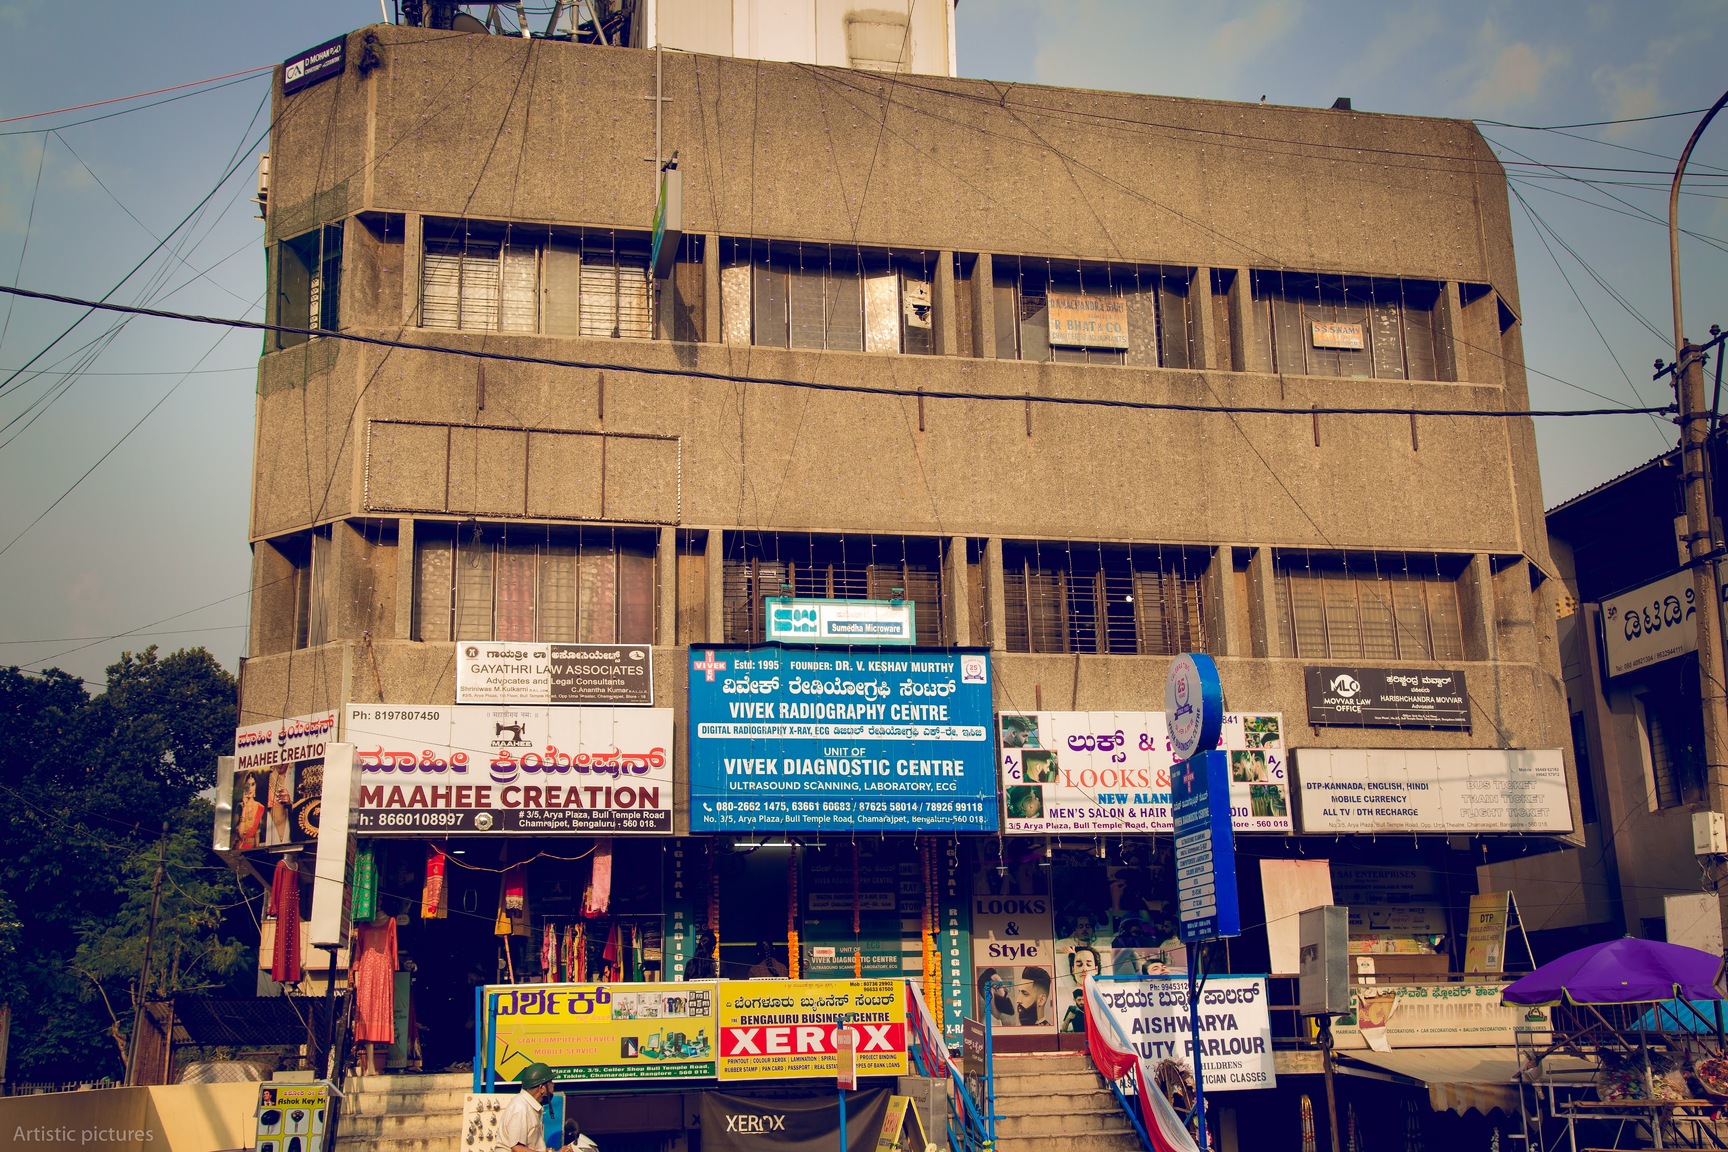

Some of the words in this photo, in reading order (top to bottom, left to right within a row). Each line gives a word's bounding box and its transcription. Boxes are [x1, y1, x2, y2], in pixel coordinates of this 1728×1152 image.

[832, 623, 864, 632] Sumedha
[865, 623, 901, 634] Microware
[533, 651, 546, 659] ಲಾ
[471, 664, 532, 674] GAYATHRI
[536, 665, 563, 675] LAW
[566, 665, 644, 676] ASSOCIATES
[734, 660, 755, 670] Estd:
[758, 660, 779, 670] 1995
[790, 661, 832, 671] FOUNDER:
[835, 661, 853, 671] DR.
[856, 661, 865, 671] V.
[868, 661, 908, 672] KESHAV
[911, 662, 954, 673] MURTHY
[486, 677, 531, 686] Advocates
[532, 677, 548, 685] and
[551, 678, 574, 687] Legal
[576, 678, 625, 686] Consultants
[722, 676, 780, 694] ವಿವೇಕ್
[899, 678, 957, 697] ಸೆಂಟರ್
[1177, 679, 1186, 693] 25
[1330, 679, 1361, 692] MLO
[1324, 698, 1355, 706] MOVVAR
[1356, 698, 1372, 706] LAW
[1380, 695, 1435, 703] HARISHCHANDRA
[1436, 696, 1463, 704] MOVVAR
[729, 702, 775, 719] VIVEK
[779, 702, 886, 720] RADIOGRAPHY
[891, 704, 949, 721] CENTRE
[1336, 705, 1361, 713] OFFICE
[353, 711, 371, 720] Ph:
[374, 711, 440, 721] 8197807450
[702, 725, 731, 735] DIGITAL
[733, 726, 786, 735] RADIOGRAPHY
[789, 726, 813, 736] X-RAY,
[815, 726, 830, 735] ECG
[824, 747, 849, 756] UNIT
[851, 747, 866, 756] OF
[1067, 730, 1127, 763] ಲುಕ್ಸ್
[1138, 733, 1156, 751] &
[238, 750, 279, 770] MAAHEE
[358, 744, 468, 773] ಮಾಹೀ
[724, 758, 778, 775] VIVEK
[784, 759, 890, 776] DIAGNOSTIC
[896, 759, 965, 776] CENTRE
[1065, 768, 1150, 788] LOOKS
[1155, 768, 1171, 788] &
[729, 781, 801, 790] ULTRASOUND
[803, 781, 861, 791] SCANNING,
[864, 782, 934, 792] LABORATORY,
[936, 782, 957, 791] ECG
[1306, 782, 1366, 791] DTP-KANNADA,
[1368, 783, 1405, 791] ENGLISH,
[1466, 780, 1491, 790] BUS
[1493, 780, 1537, 790] TICKET
[360, 786, 492, 808] MAAHEE
[501, 786, 659, 808] CREATION
[1098, 793, 1129, 804] NEW
[1331, 795, 1362, 803] MOBILE
[1364, 795, 1407, 803] CURRENCY
[1461, 794, 1498, 804] TRAIN
[1500, 794, 1545, 804] TICKET
[716, 801, 761, 811] 080-2662
[763, 801, 789, 812] 1475,
[791, 801, 820, 811] 63661
[822, 801, 851, 811] 60683
[859, 802, 887, 811] 87625
[890, 802, 917, 812] 58014
[925, 802, 953, 812] 78926
[955, 802, 983, 812] 99118
[1323, 808, 1338, 816] ALL
[1339, 808, 1350, 816] TV
[1357, 808, 1373, 816] DTH
[1375, 808, 1419, 816] RECHARGE
[526, 811, 541, 819] 3/5,
[543, 812, 563, 820] Arya
[565, 811, 590, 820] Plaza,
[592, 811, 609, 819] Bull
[611, 812, 643, 820] Temple
[1050, 808, 1085, 818] MEN'S
[1088, 808, 1125, 818] SALON
[1128, 808, 1137, 818] &
[1140, 808, 1167, 818] HAIR
[1459, 808, 1504, 817] FLIGHT
[1505, 808, 1550, 817] TICKET
[378, 813, 465, 826] 8660108997
[572, 820, 615, 829] Bengaluru
[623, 820, 638, 828] 560
[639, 820, 657, 828] 018.
[1257, 820, 1271, 828] 560
[1273, 820, 1289, 828] 018
[1008, 822, 1021, 830] 3/5
[1023, 822, 1043, 831] Arya
[1046, 822, 1071, 831] Plaza,
[1073, 821, 1090, 829] Bull
[1092, 822, 1123, 831] Temple
[1125, 821, 1148, 830] Road,
[976, 899, 1047, 915] LOOKS
[1480, 913, 1494, 923] DTP
[1005, 921, 1020, 936] &
[988, 943, 1038, 961] Style
[855, 993, 895, 1006] ಸೆಂಟರ್
[740, 1014, 799, 1026] BENGALURU
[854, 1012, 890, 1022] CENTRE
[538, 1036, 582, 1044] COMPUTER
[583, 1035, 616, 1043] SERVICE
[1230, 1071, 1267, 1083] CLASSES
[277, 1098, 300, 1106] Ashok
[302, 1098, 316, 1106] Key
